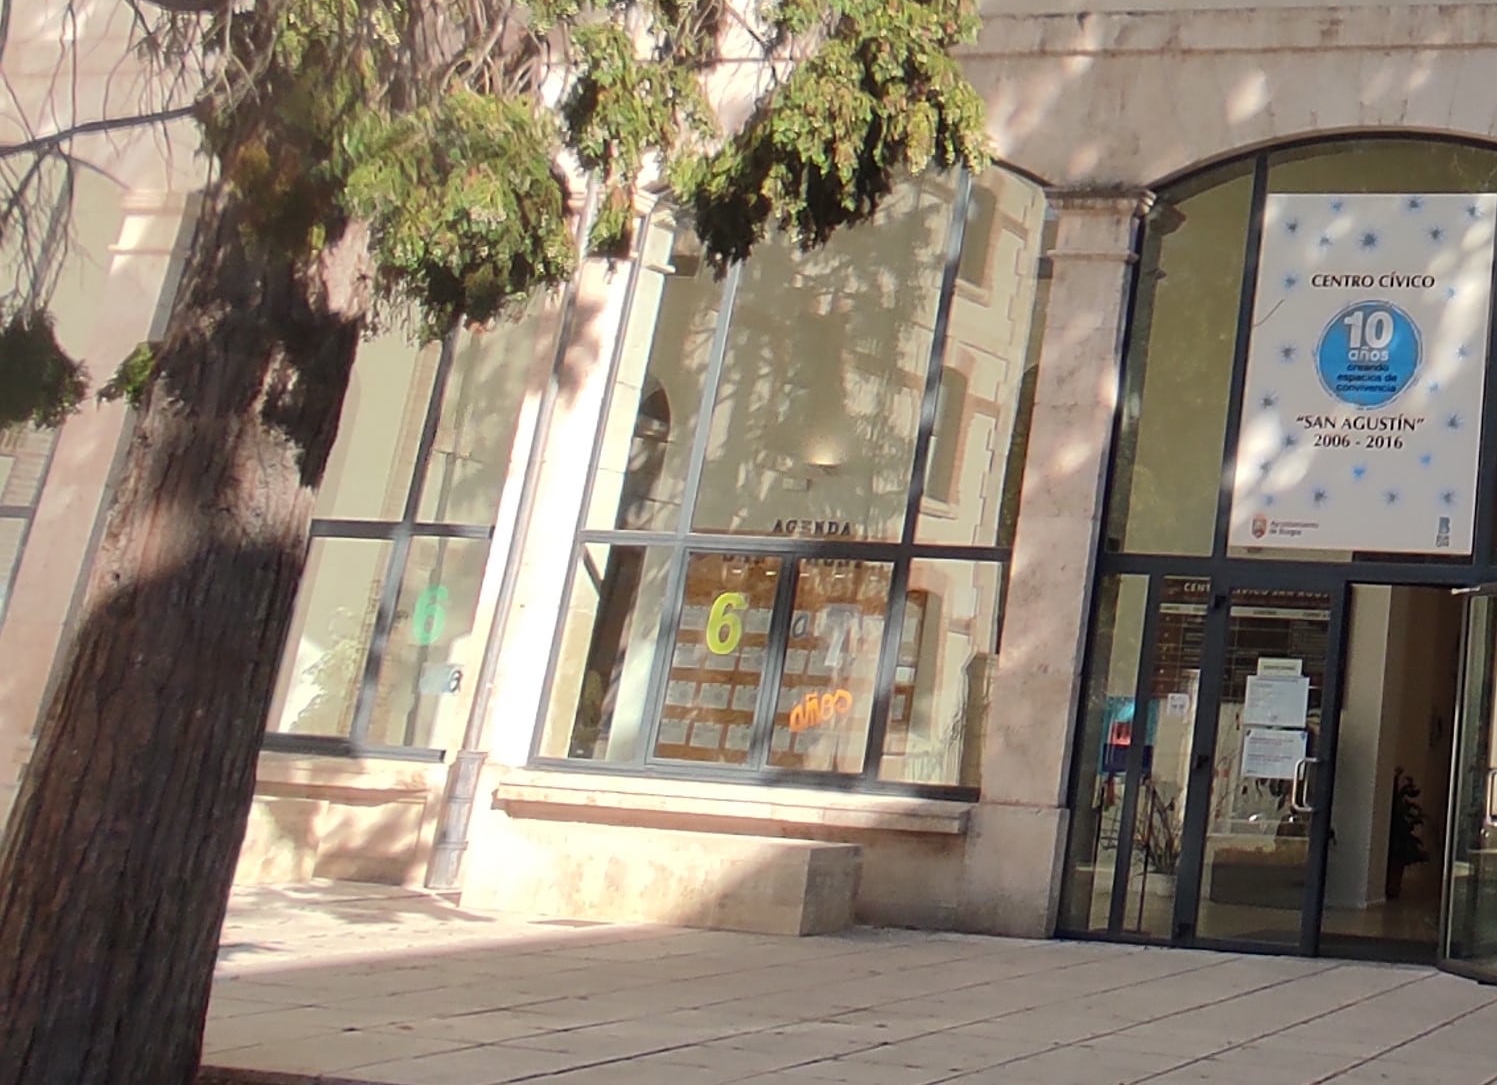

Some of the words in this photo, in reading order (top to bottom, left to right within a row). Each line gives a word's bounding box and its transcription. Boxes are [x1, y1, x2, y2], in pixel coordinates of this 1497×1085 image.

[1311, 274, 1374, 288] CENTRO
[1379, 271, 1435, 288] CÍVICO
[1344, 311, 1394, 349] 10
[1348, 346, 1389, 361] años
[1314, 434, 1350, 447] 2006
[1366, 435, 1403, 448] 2016
[773, 519, 850, 536] AGENDA
[412, 585, 449, 646] 6
[706, 592, 748, 655] 6
